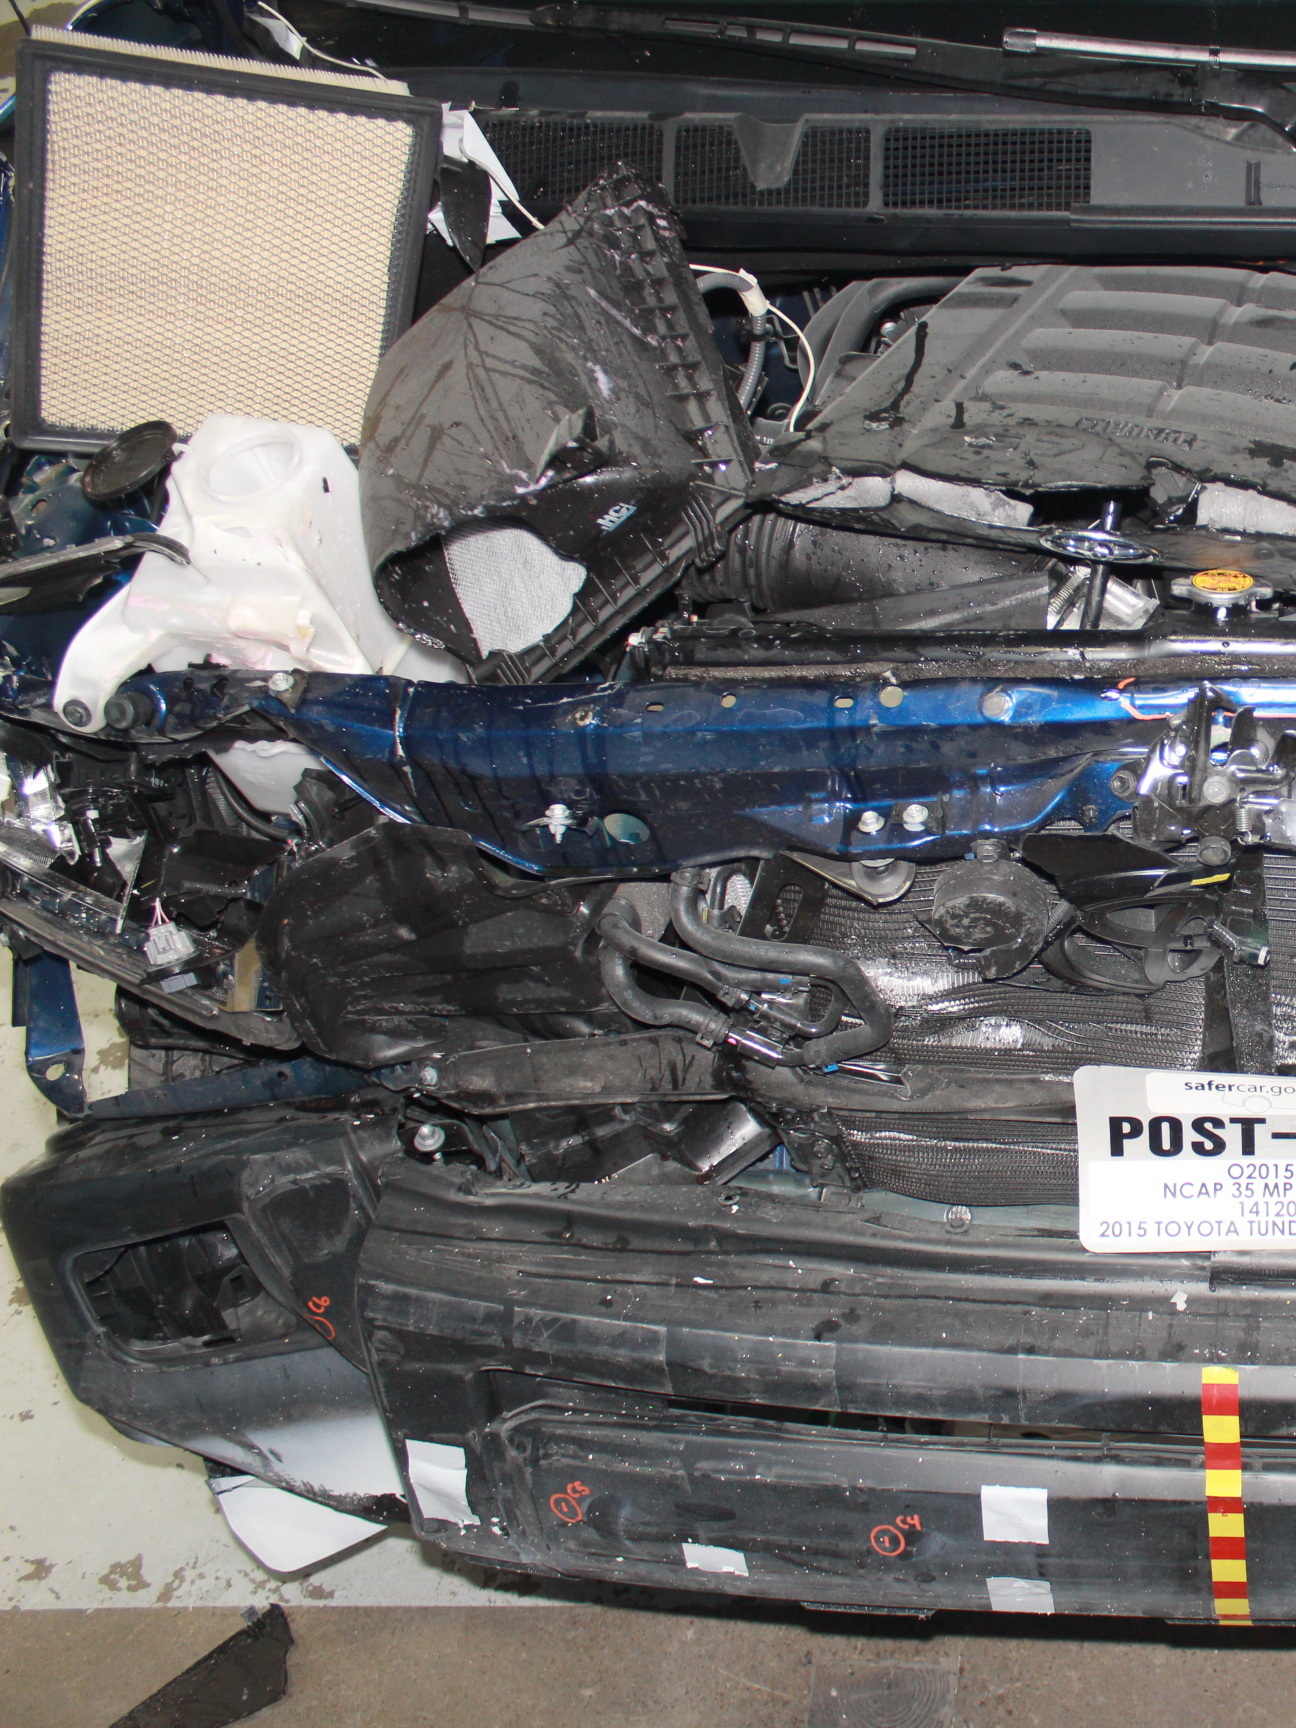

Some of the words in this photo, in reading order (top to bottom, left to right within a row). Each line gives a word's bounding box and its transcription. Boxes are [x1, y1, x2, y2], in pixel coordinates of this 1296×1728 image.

[1163, 1182, 1224, 1199] NCAP
[1231, 1182, 1255, 1199] 35
[1099, 1220, 1148, 1238] 2015
[1154, 1220, 1240, 1238] TOYOTA
[566, 1480, 591, 1498] C5
[895, 1513, 922, 1531] C4
